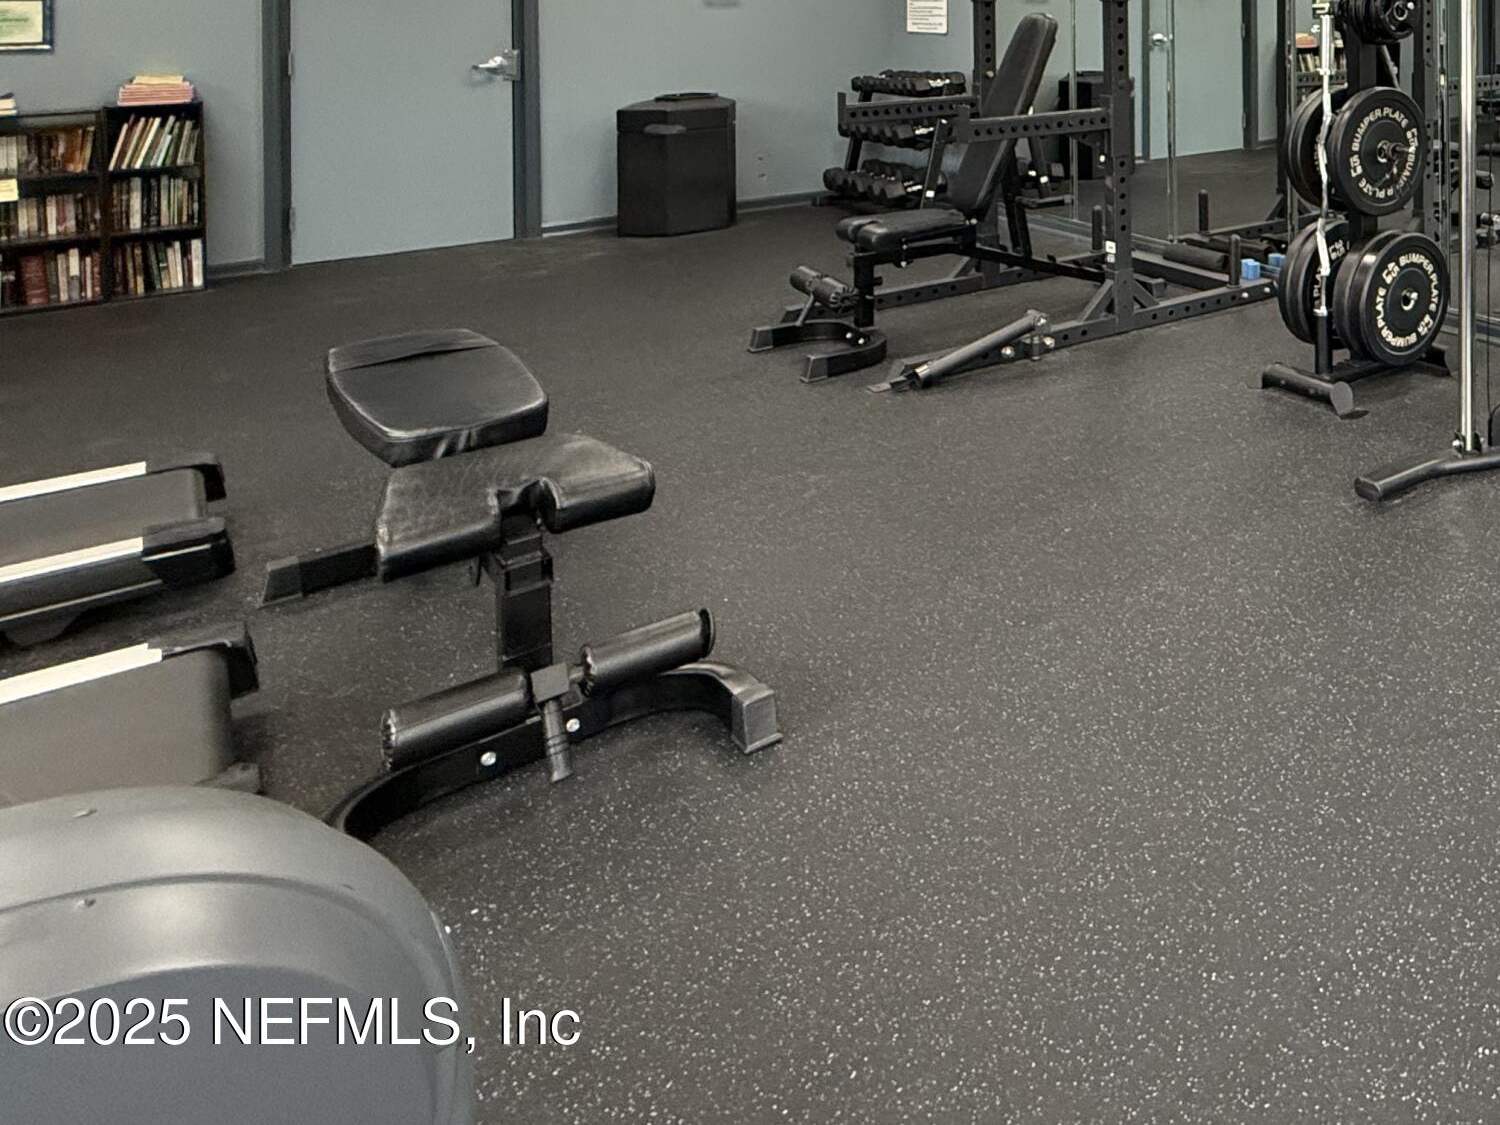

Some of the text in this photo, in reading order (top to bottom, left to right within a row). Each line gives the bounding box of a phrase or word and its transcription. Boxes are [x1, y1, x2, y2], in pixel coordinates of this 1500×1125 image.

[1351, 107, 1409, 152] BUMPER PLATE
[1358, 177, 1386, 198] PLATE
[1399, 253, 1439, 312] BUMPER PLATE
[1376, 286, 1418, 347] BUMPER PLATE
